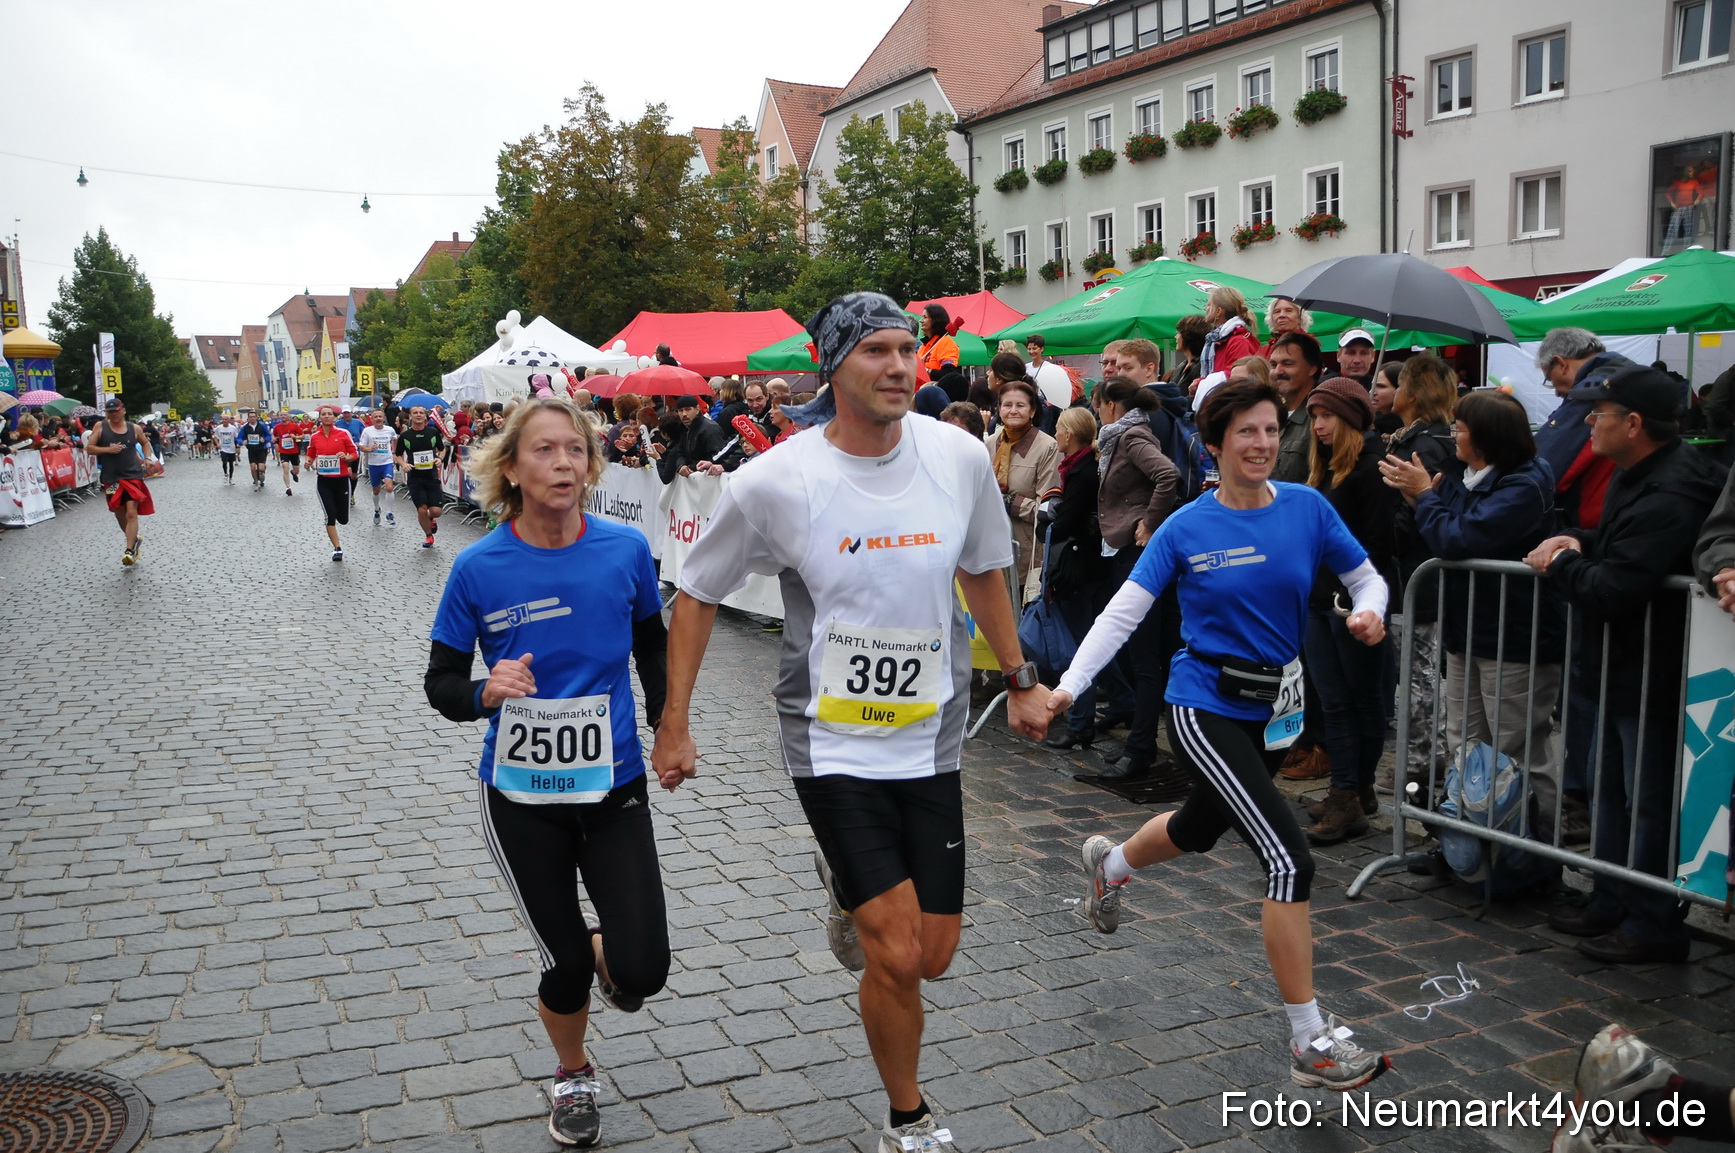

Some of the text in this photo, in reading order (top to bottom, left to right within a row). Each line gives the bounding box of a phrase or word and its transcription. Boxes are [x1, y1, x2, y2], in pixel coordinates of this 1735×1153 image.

[1395, 89, 1404, 131] Achatz
[1570, 298, 1662, 312] Lammsbräu
[107, 375, 117, 388] B
[362, 373, 370, 386] B
[495, 387, 522, 397] Kinder
[319, 459, 338, 468] 3017
[420, 455, 429, 463] 84
[604, 493, 643, 525] Laufsport
[668, 508, 700, 544] Audi
[866, 532, 942, 550] KLEBL
[827, 632, 928, 653] PARTL Neumarkt
[846, 654, 922, 697] 392
[1277, 677, 1302, 718] 24
[504, 704, 593, 721] PARTL Neumarkt
[861, 706, 896, 723] Uwe
[507, 722, 602, 765] 2500
[531, 774, 575, 793] Helga
